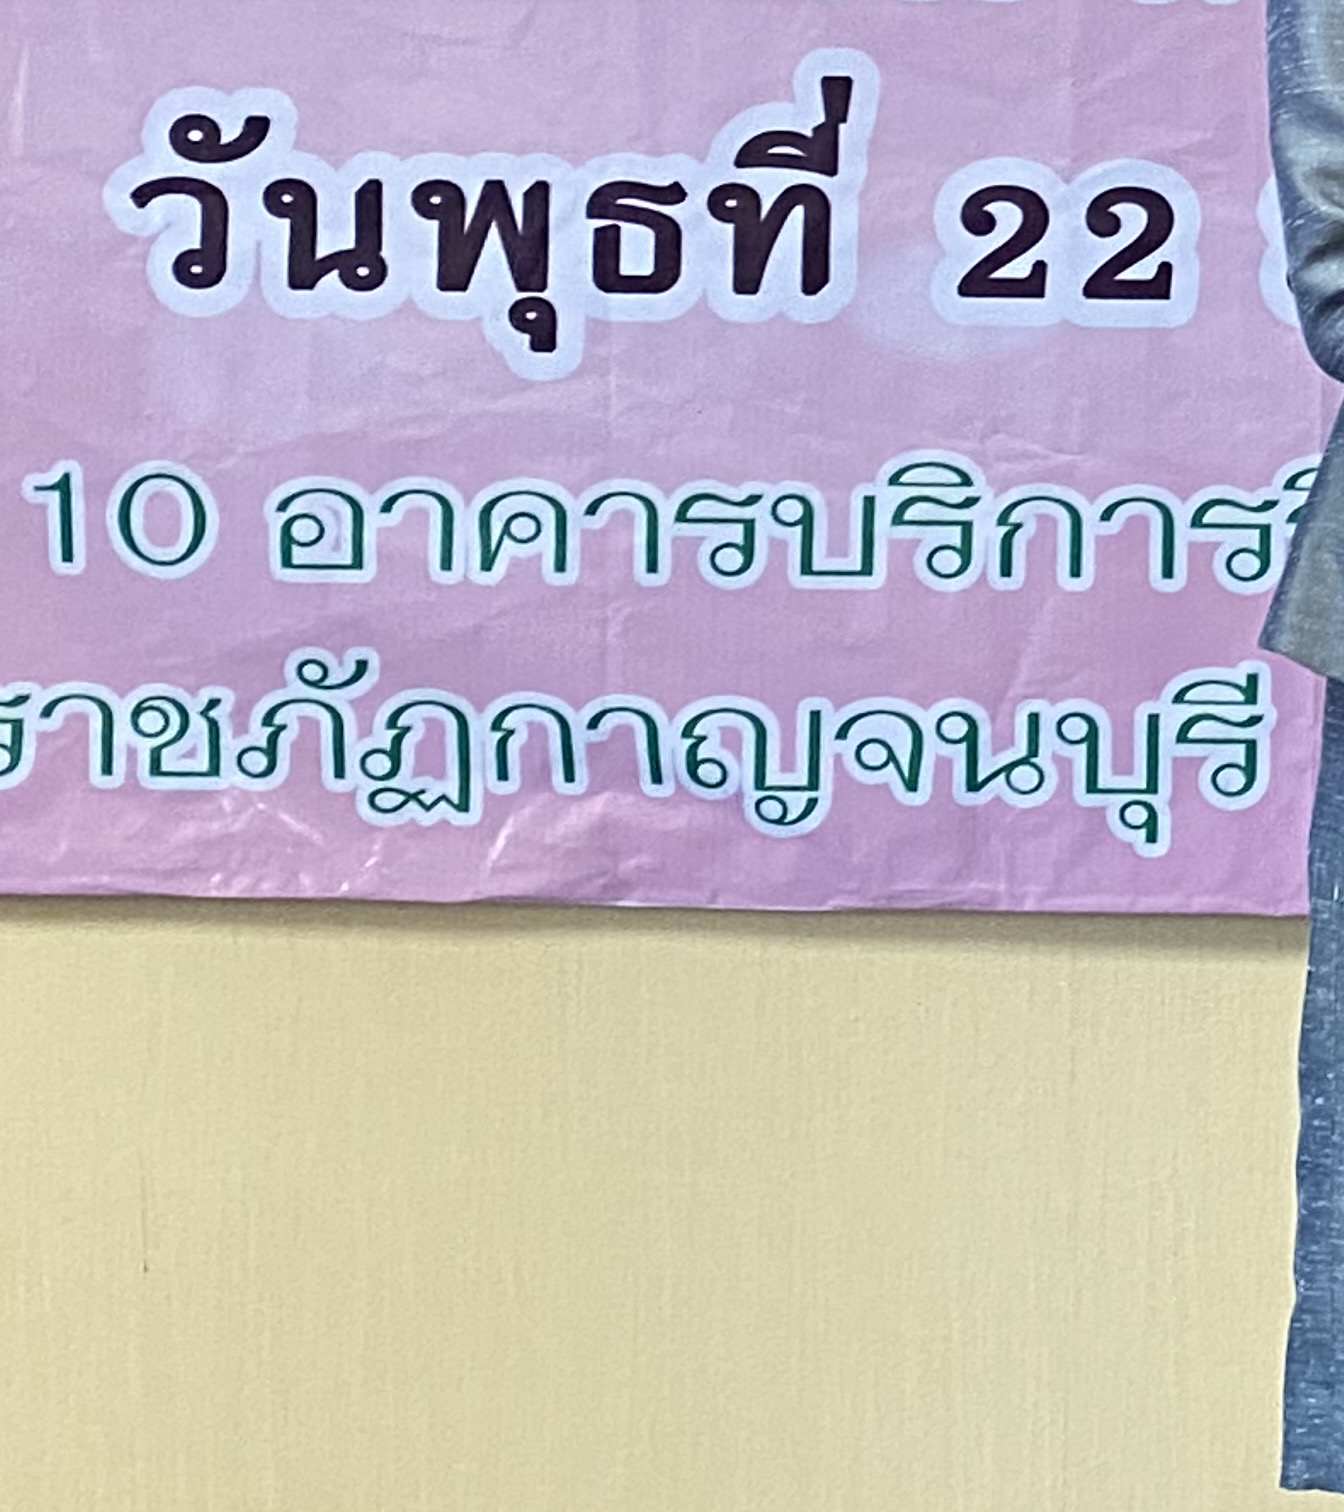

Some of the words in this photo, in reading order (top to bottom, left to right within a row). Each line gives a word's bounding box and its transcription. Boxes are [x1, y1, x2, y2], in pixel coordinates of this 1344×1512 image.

[131, 76, 853, 353] วันพุธที่
[957, 185, 1175, 300] 22
[34, 472, 206, 566] 10
[278, 462, 1318, 582] อาคารบริการ
